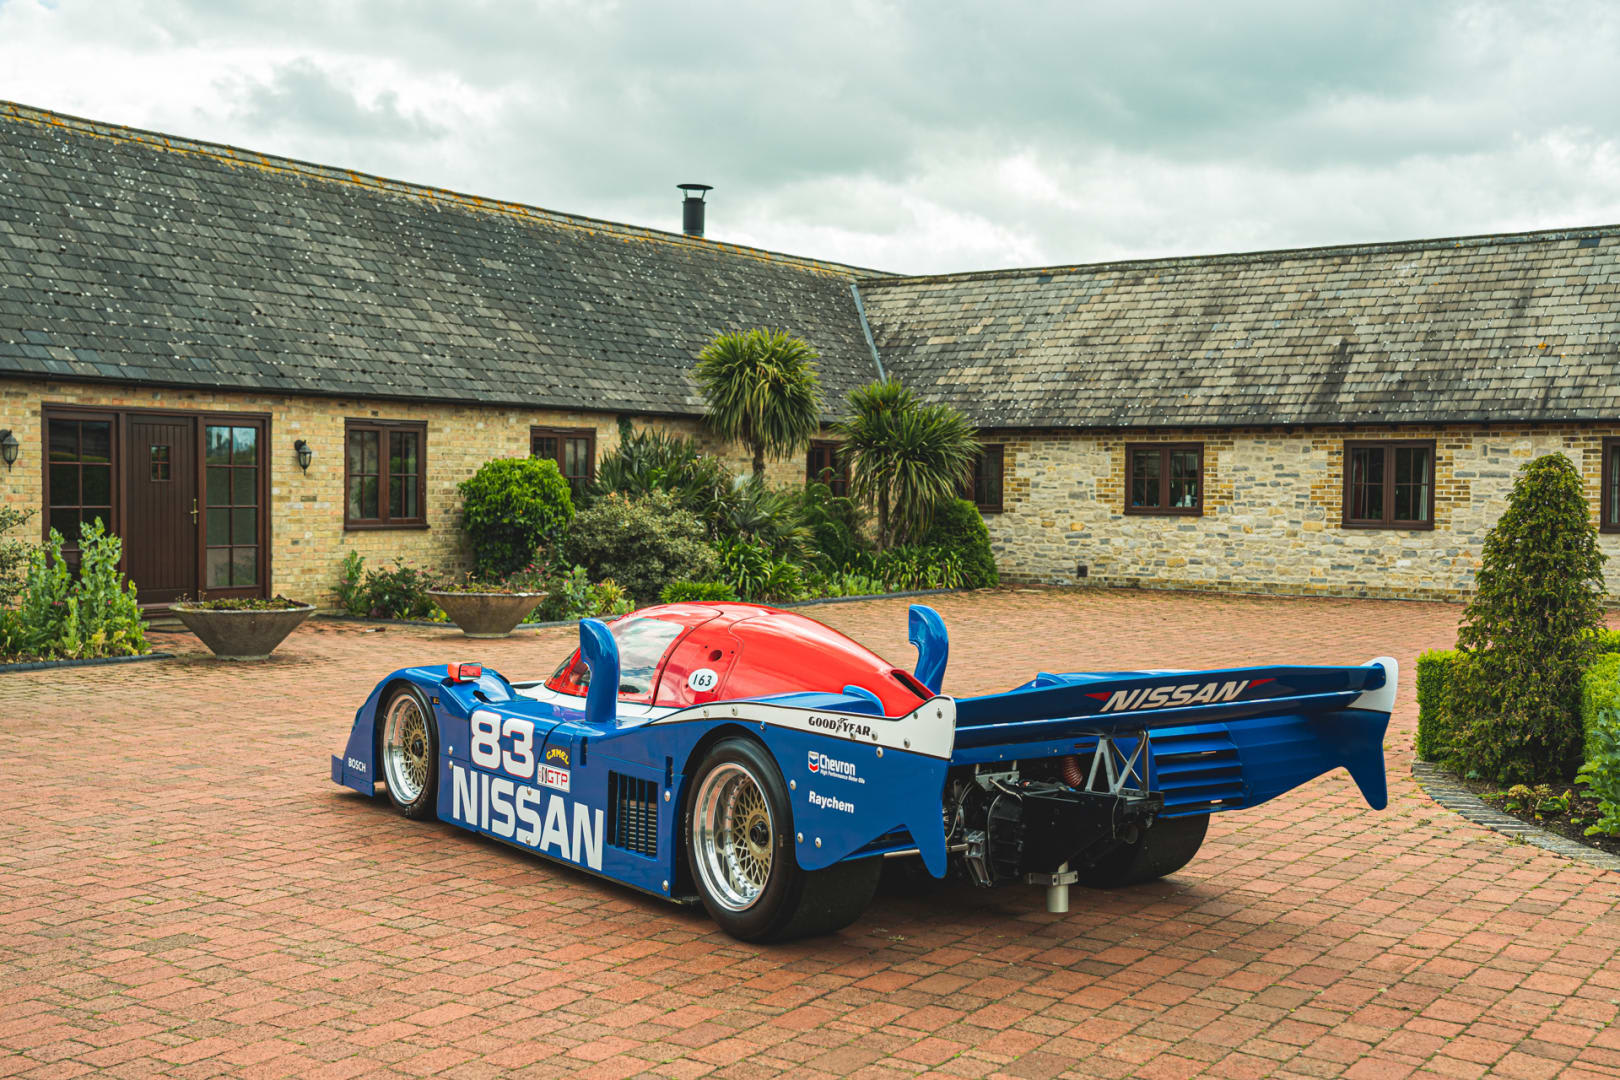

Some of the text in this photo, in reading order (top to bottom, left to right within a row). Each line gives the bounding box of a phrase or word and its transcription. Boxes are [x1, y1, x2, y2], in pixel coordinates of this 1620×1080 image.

[693, 674, 712, 687] 163
[1100, 680, 1250, 712] NISSAN
[470, 709, 535, 779] 83
[347, 757, 367, 773] BOSCH
[546, 748, 569, 765] CAMEL
[819, 754, 856, 776] Chevron
[808, 790, 854, 814] Raychem
[452, 765, 604, 871] NISSAN
